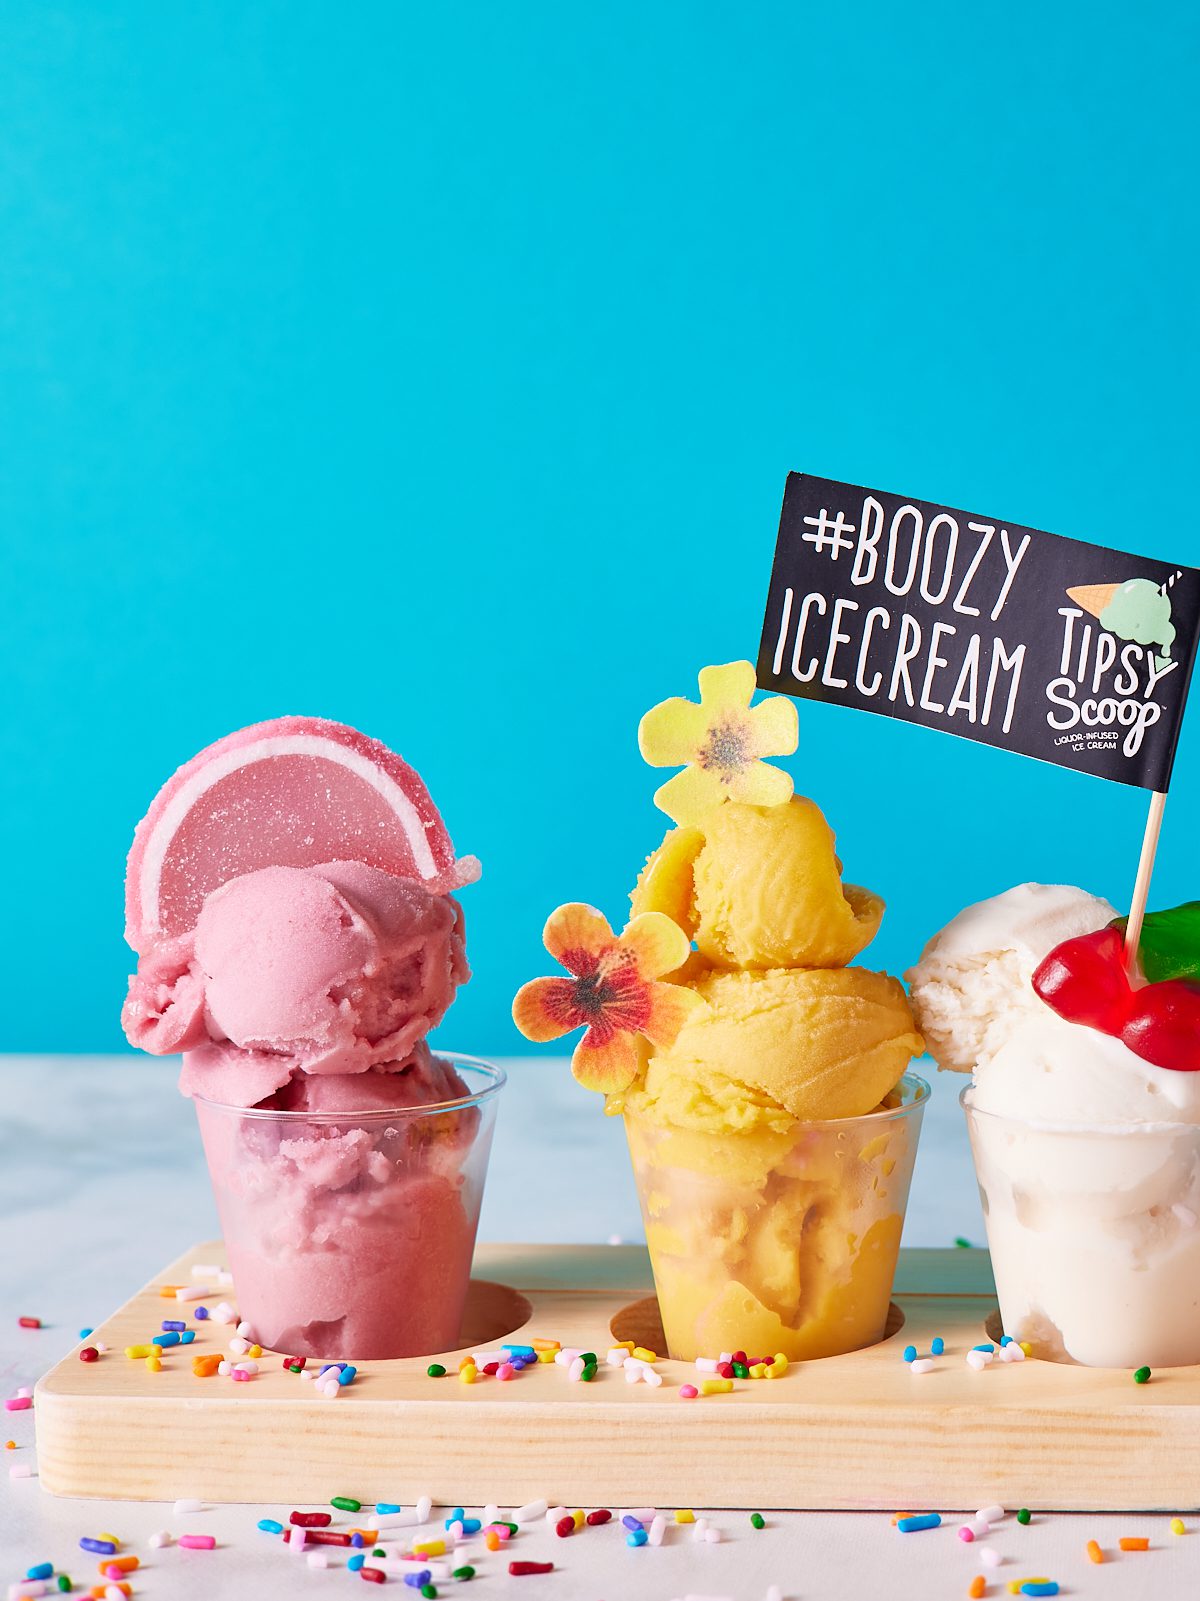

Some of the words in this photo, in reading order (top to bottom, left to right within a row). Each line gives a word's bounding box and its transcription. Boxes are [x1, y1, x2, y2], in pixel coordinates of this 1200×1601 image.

[801, 495, 1031, 621] #BOOZY
[772, 587, 1026, 734] ICECREAM
[1057, 607, 1179, 698] TIPSY
[1045, 677, 1161, 757] Scoop
[1054, 732, 1119, 746] LIQUOR-INFUSED
[1072, 743, 1085, 752] ICE
[1087, 741, 1117, 750] CREAM
